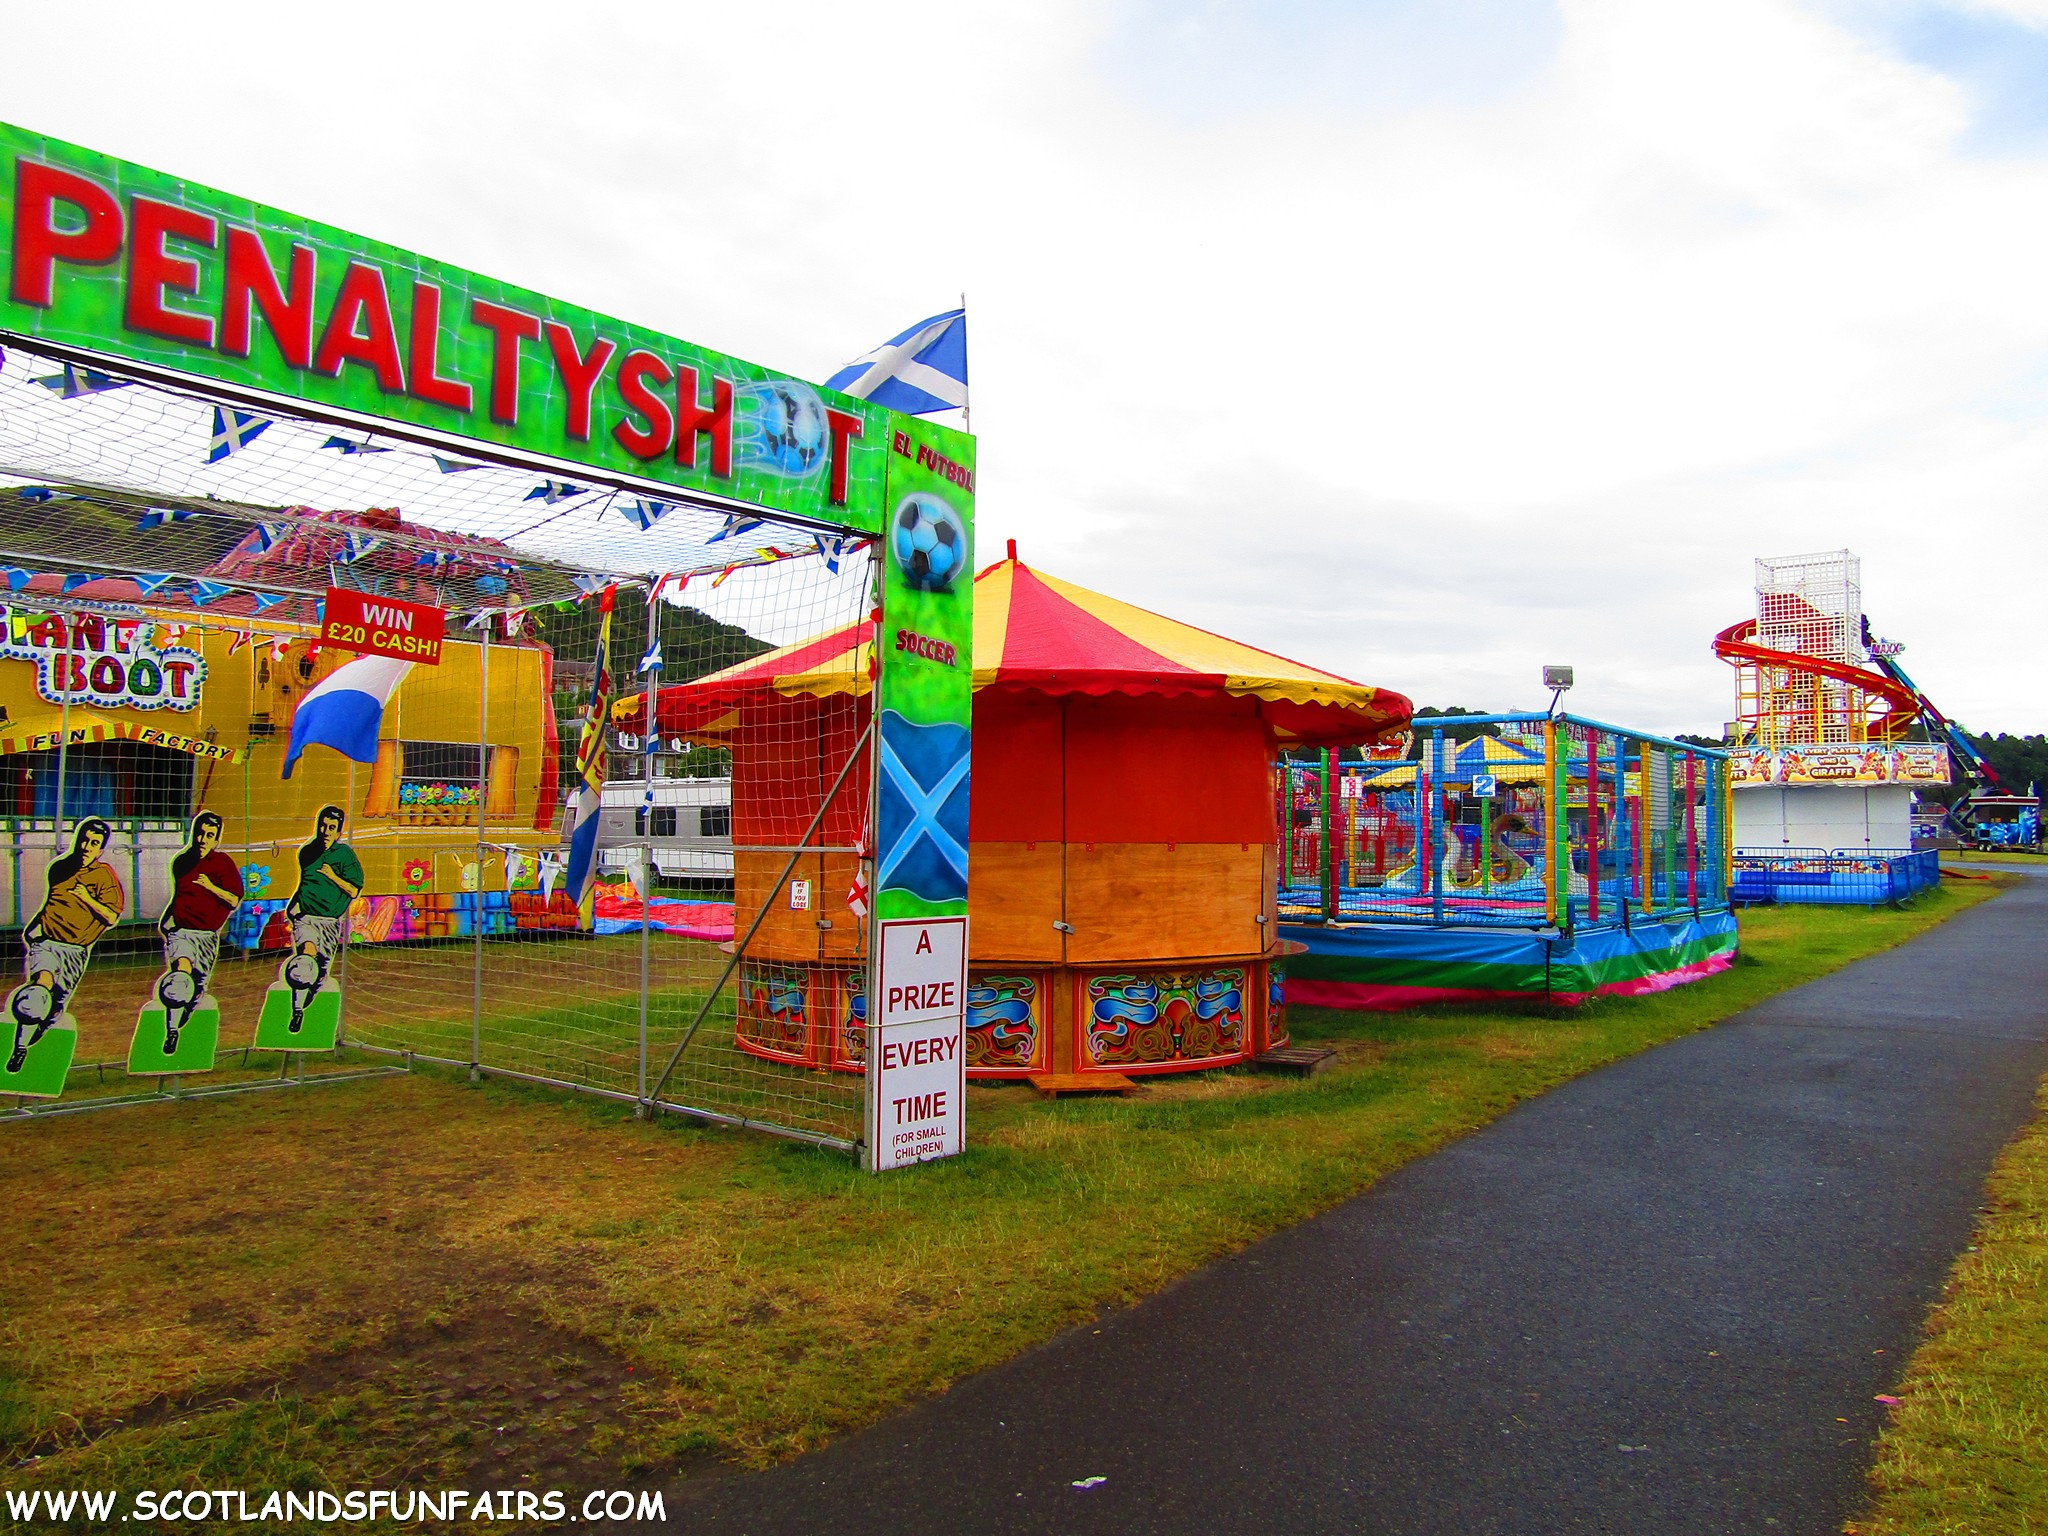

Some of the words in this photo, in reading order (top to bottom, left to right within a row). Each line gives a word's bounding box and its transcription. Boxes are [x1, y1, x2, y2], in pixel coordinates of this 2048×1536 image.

[893, 429, 913, 459] EL
[916, 443, 974, 493] FUTBOL
[0, 604, 141, 654] IANT
[362, 602, 414, 632] WIN
[327, 622, 366, 644] £20
[372, 630, 439, 657] CASH!
[896, 629, 957, 667] SOCCER
[54, 653, 195, 698] BOOT
[33, 729, 86, 749] FUN
[141, 729, 233, 760] FACTORY
[1804, 747, 1829, 755] EVERY
[1831, 747, 1861, 755] PLAYER
[1811, 768, 1855, 778] GIRAFFE
[1818, 757, 1839, 765] WINS
[1840, 756, 1848, 765] A
[1475, 775, 1494, 796] 2
[915, 929, 933, 954] A
[888, 981, 955, 1013] PRIZE
[882, 1034, 959, 1071] EVERY
[892, 1091, 947, 1125] TIME
[892, 1131, 914, 1148] (FOR
[916, 1126, 947, 1141] SMALL
[895, 1141, 944, 1160] CHILDREN)
